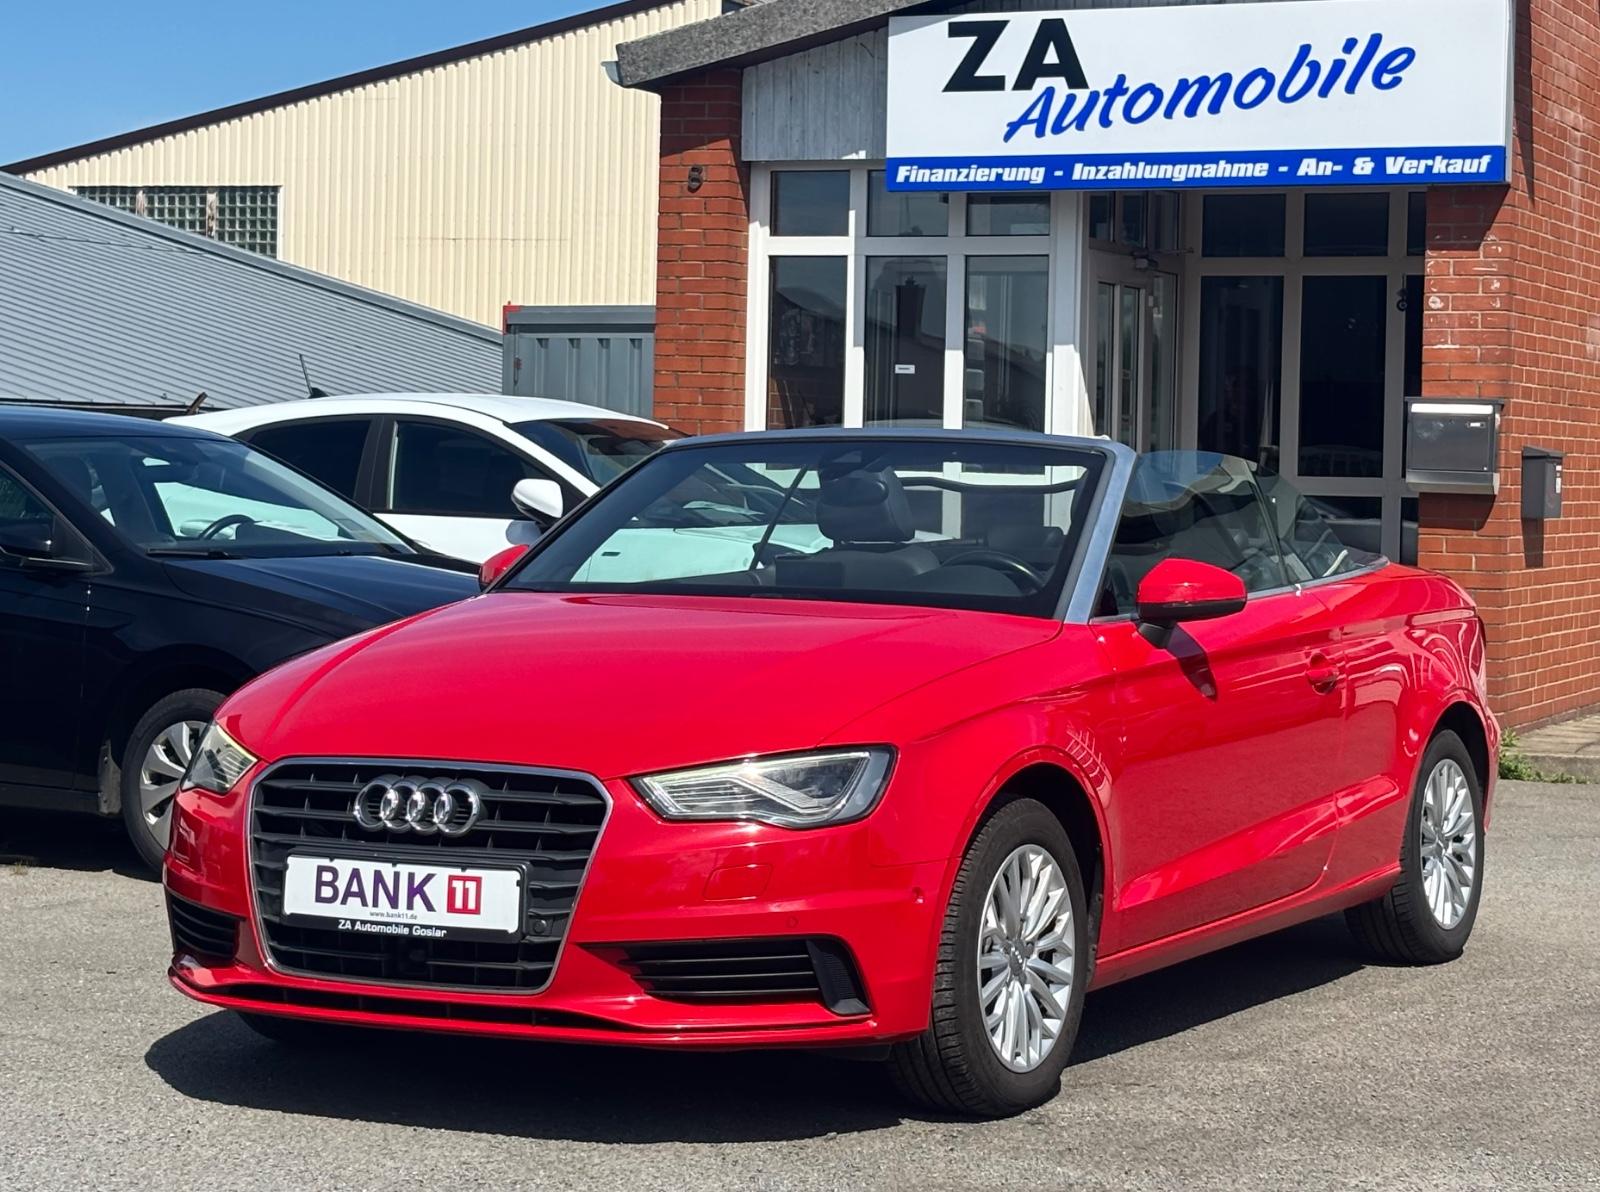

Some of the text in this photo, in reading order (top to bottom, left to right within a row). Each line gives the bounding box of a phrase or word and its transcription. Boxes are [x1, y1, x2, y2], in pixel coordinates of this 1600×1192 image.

[942, 18, 1090, 92] ZA
[1002, 32, 1416, 143] Automobile
[896, 164, 1045, 184] Finanzierung
[1072, 160, 1268, 181] Inzahlungnahme
[1297, 157, 1343, 176] An-
[1352, 157, 1376, 175] &
[1385, 154, 1492, 175] Verkauf
[314, 864, 476, 912] BANK 11
[338, 919, 447, 938] ZA Automobile Goslar
[369, 911, 418, 920] www.bank11.de
